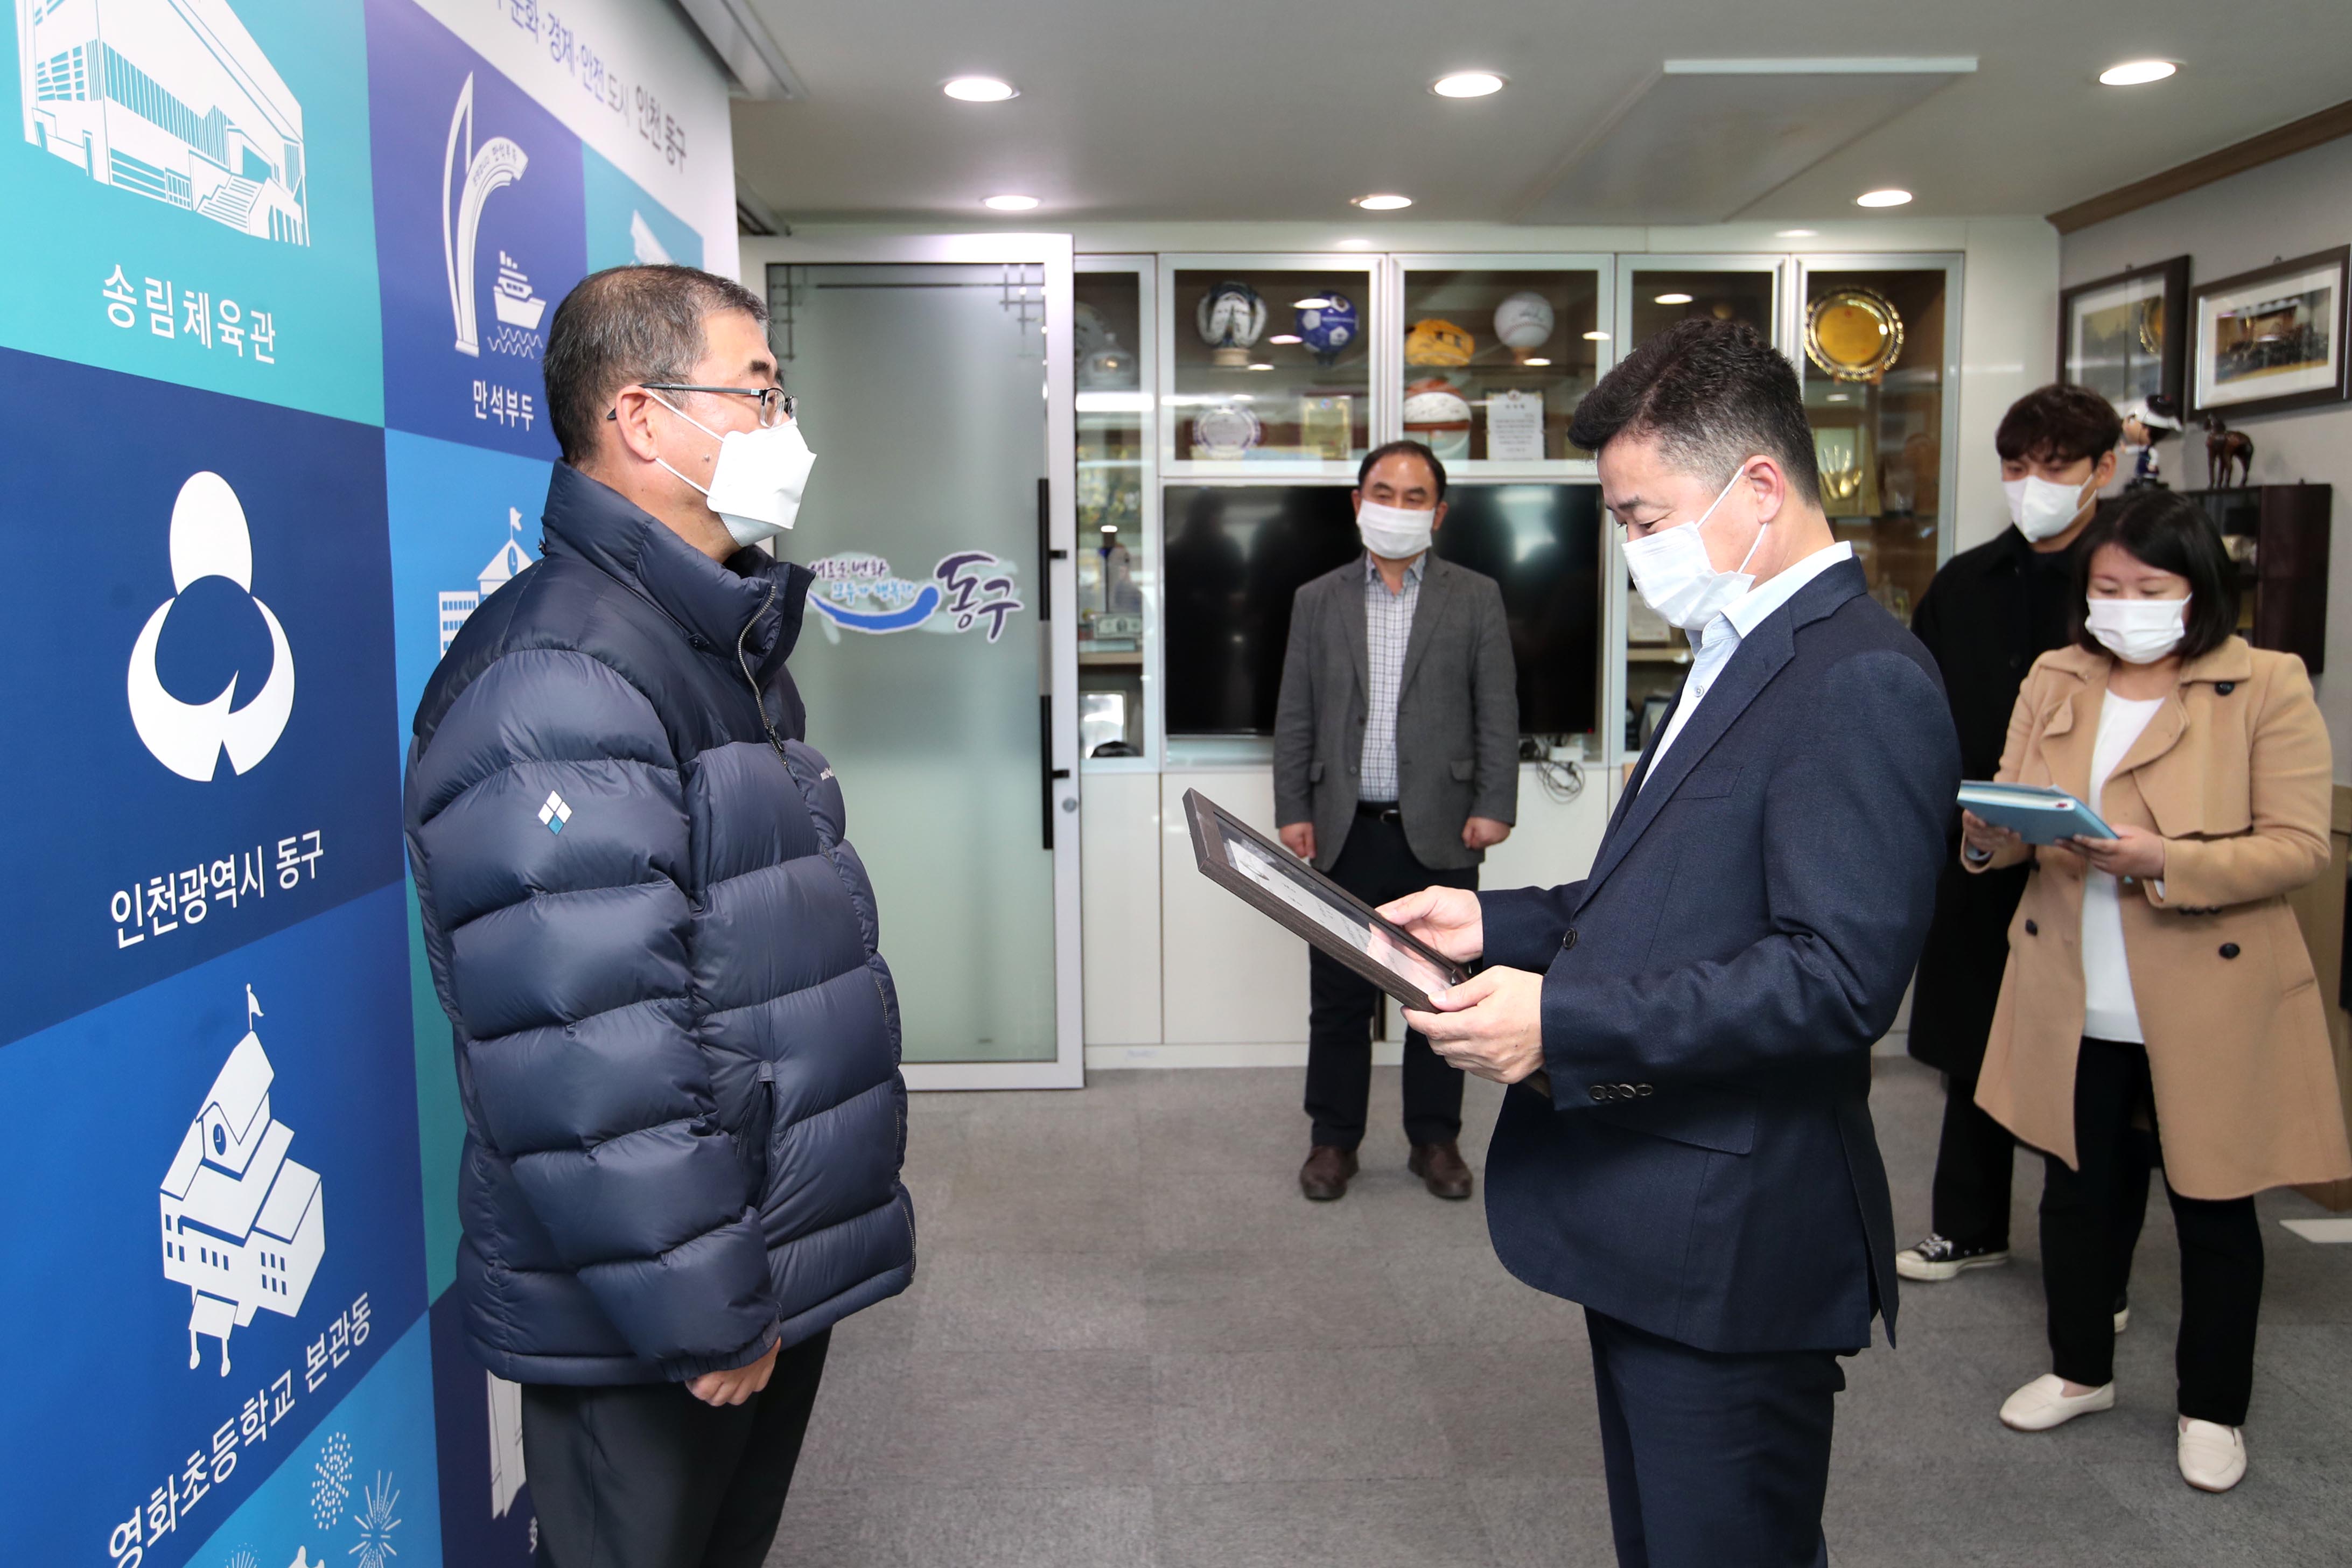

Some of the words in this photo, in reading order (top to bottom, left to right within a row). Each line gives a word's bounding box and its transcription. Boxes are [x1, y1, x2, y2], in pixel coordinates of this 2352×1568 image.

[608, 73, 629, 127] 도시
[636, 85, 662, 152] 인천
[665, 113, 687, 174] 동구
[102, 264, 276, 365] 송림체육관
[473, 379, 534, 432] 만석부두
[851, 559, 887, 578] 변화
[935, 552, 1022, 641] 동구
[110, 845, 265, 949] 인천광역시
[276, 829, 324, 890] 동구
[109, 1369, 296, 1568] 영화초등학교
[305, 1291, 372, 1394] 본관동
